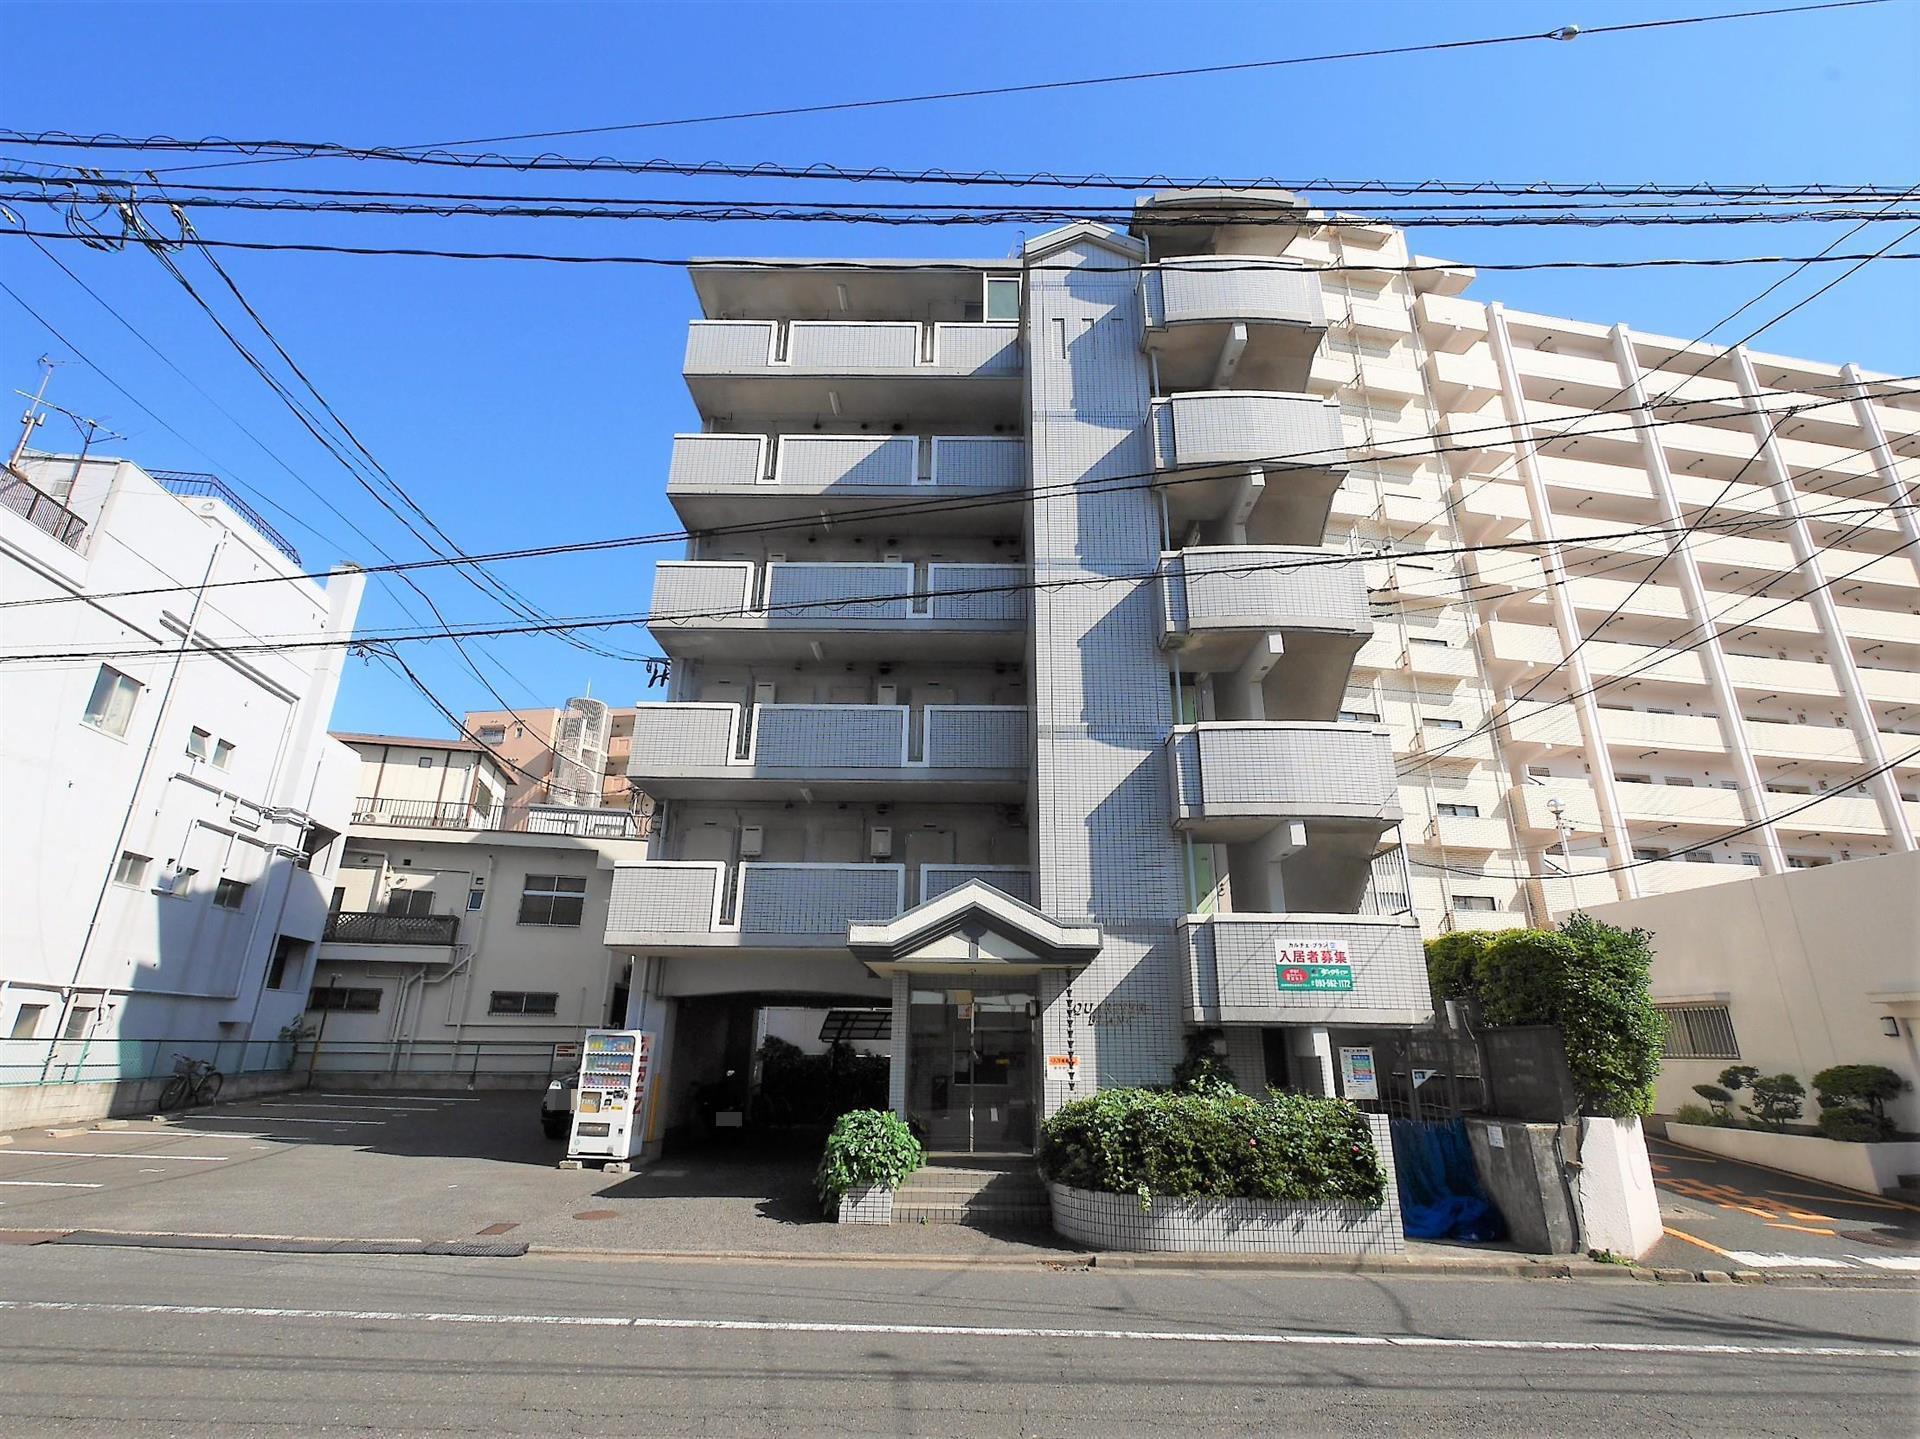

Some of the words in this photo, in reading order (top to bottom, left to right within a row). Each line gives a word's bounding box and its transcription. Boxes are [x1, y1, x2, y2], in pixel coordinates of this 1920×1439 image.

[1279, 949, 1347, 964] 入居者募集
